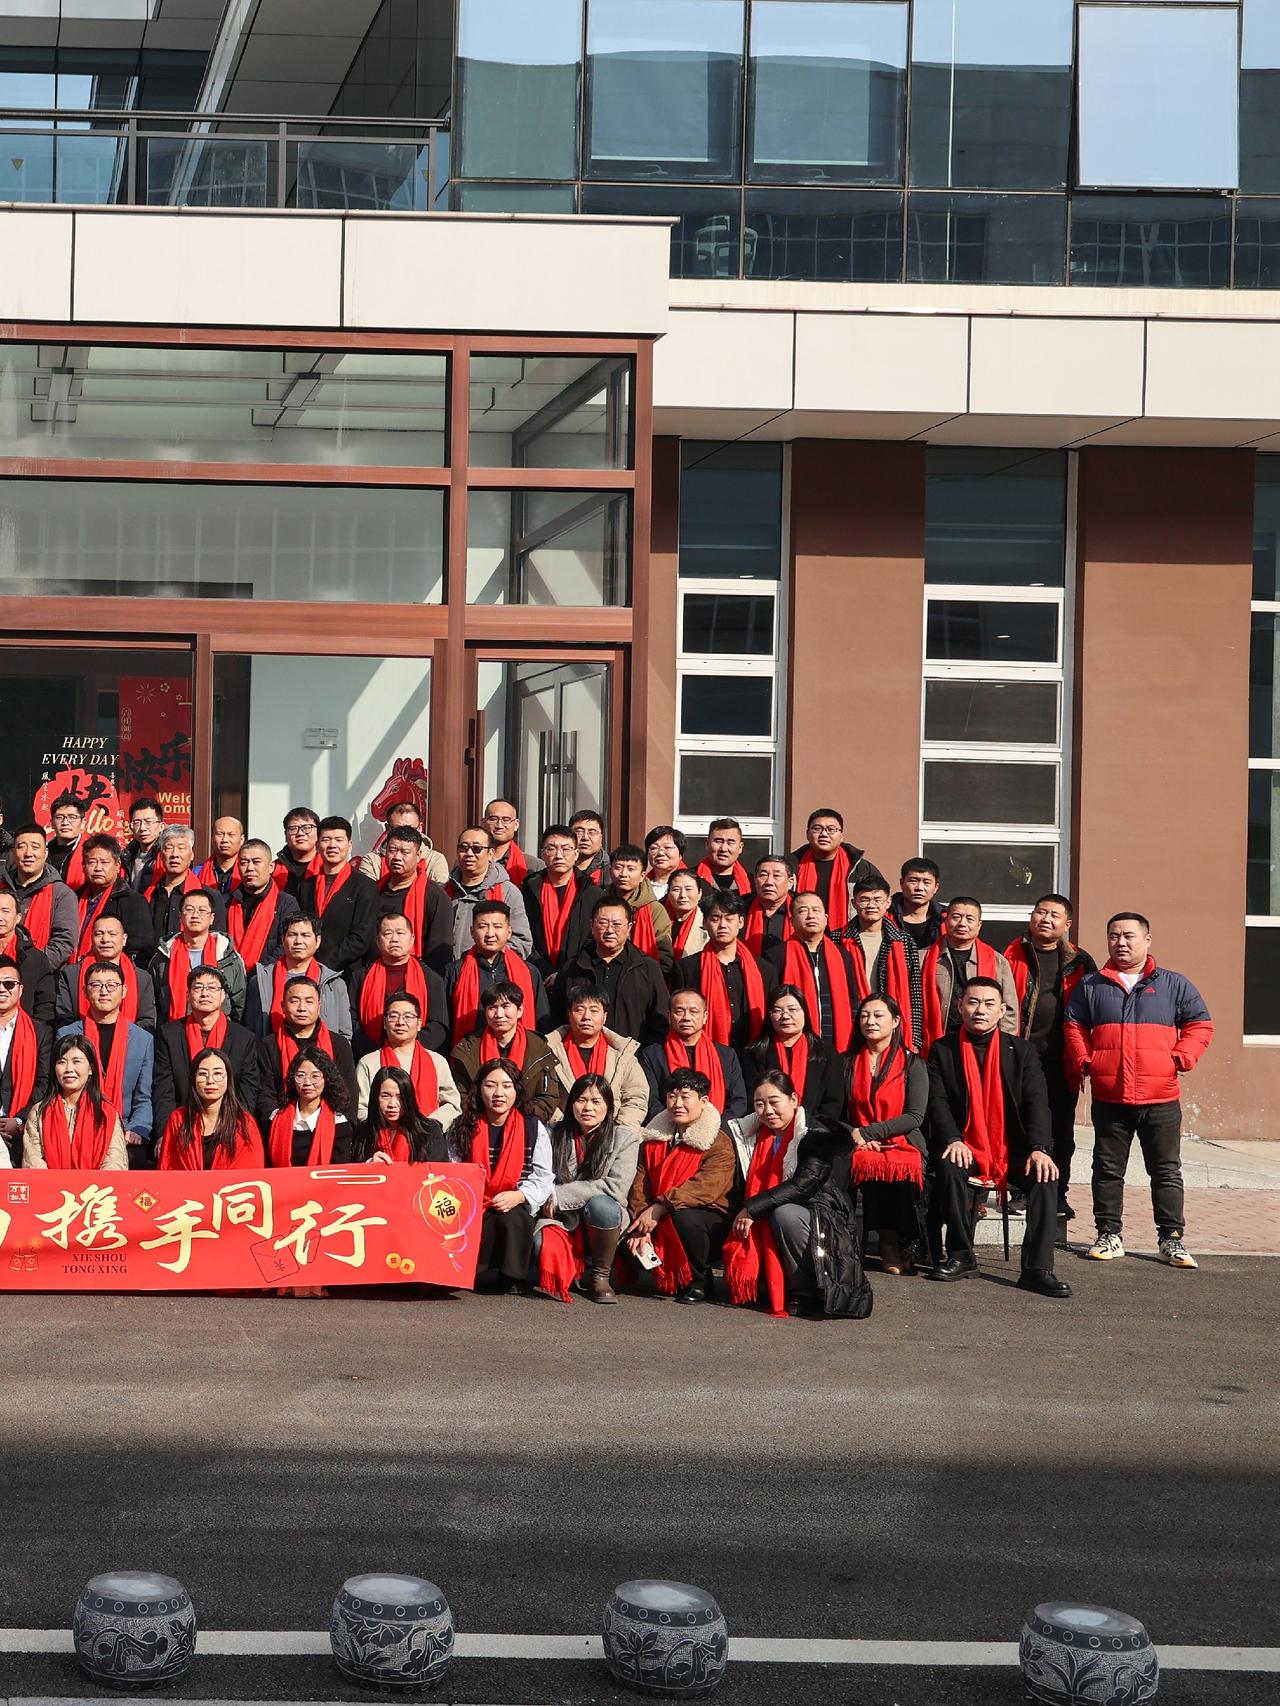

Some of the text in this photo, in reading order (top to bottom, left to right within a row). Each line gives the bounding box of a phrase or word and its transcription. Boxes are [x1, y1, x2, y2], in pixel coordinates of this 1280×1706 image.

[62, 737, 108, 749] HAPPY
[41, 753, 120, 766] EVERY DAY
[434, 1196, 456, 1219] 福
[72, 1253, 127, 1262] XIE SHOU
[61, 1264, 128, 1274] TONG XING
